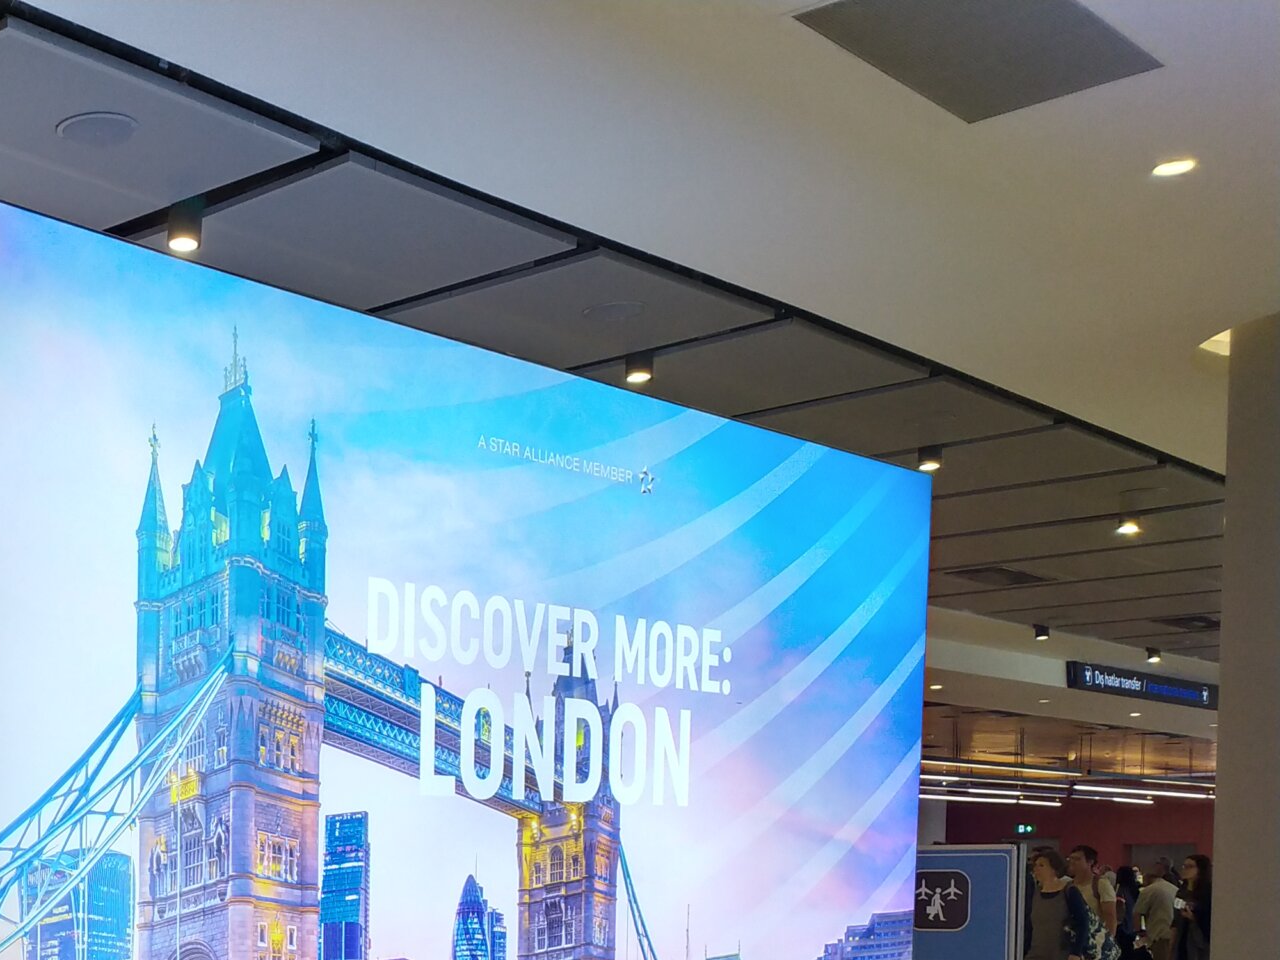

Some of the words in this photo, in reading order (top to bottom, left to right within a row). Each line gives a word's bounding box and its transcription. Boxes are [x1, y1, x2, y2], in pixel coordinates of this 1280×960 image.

[477, 434, 487, 449] A
[489, 437, 520, 457] STAR
[523, 446, 580, 472] ALLIANCE
[583, 459, 633, 484] MEMBER
[367, 576, 600, 680] DISCOVER
[614, 614, 733, 695] MORE:
[1104, 672, 1121, 687] hatlar
[1121, 677, 1141, 691] transfer
[419, 682, 692, 807] LONDON
